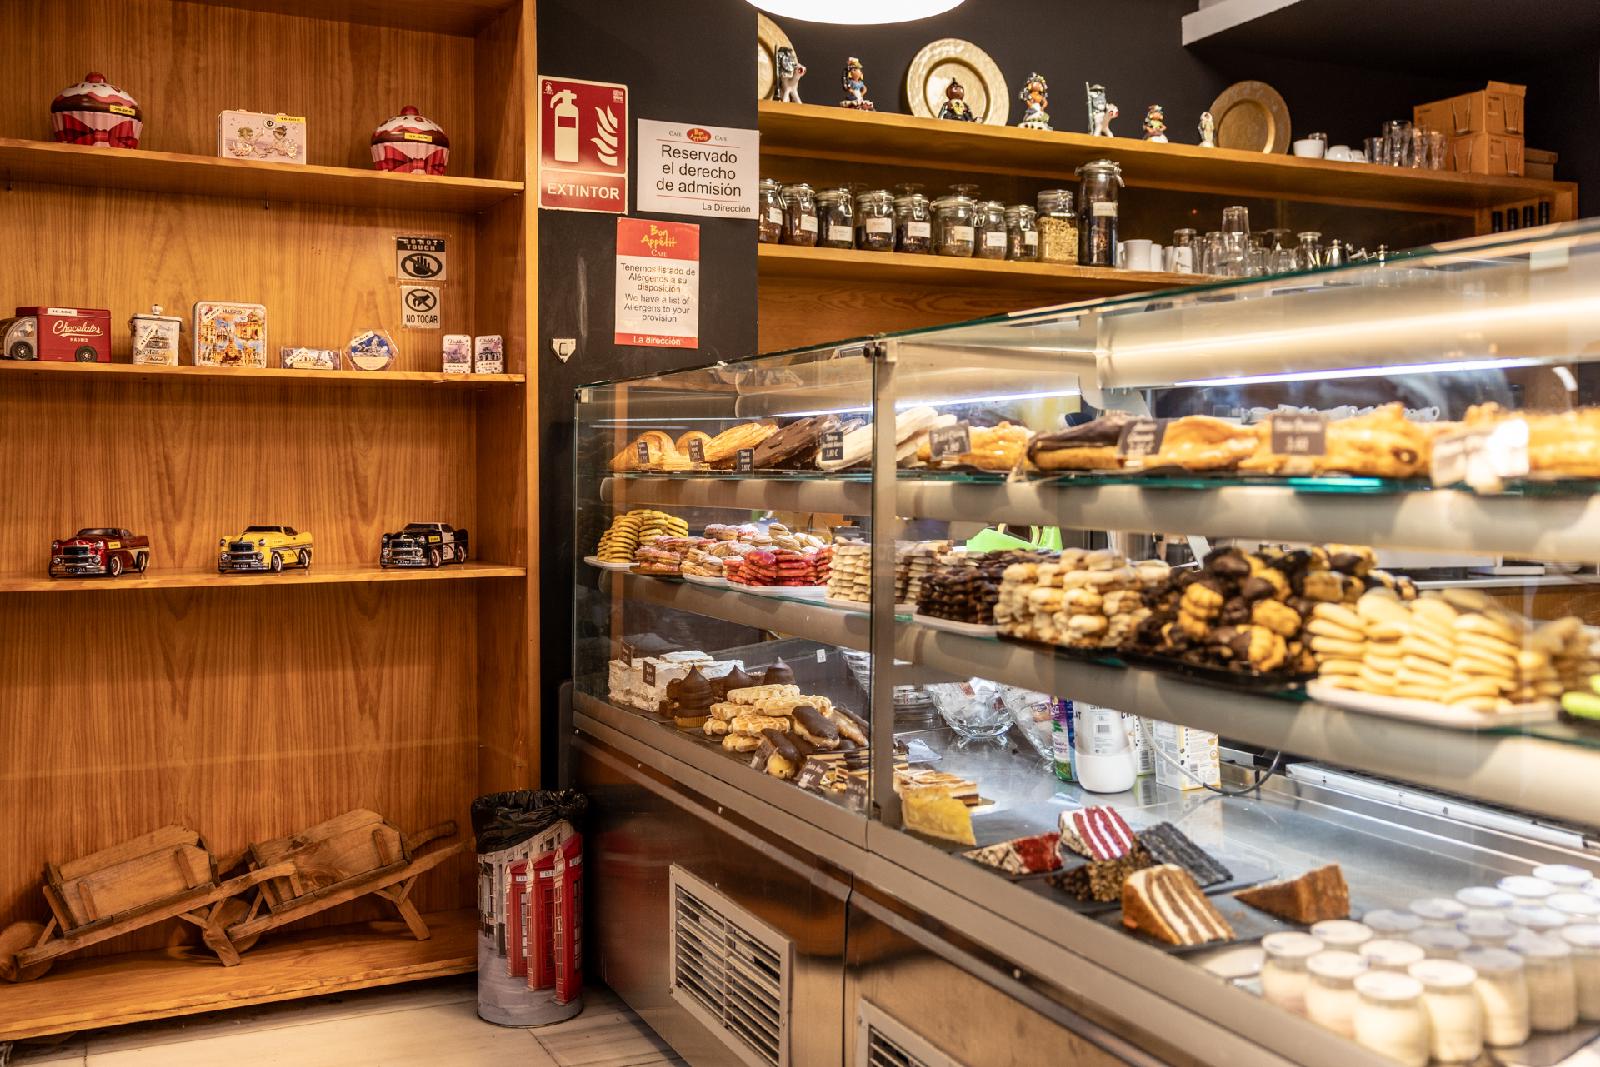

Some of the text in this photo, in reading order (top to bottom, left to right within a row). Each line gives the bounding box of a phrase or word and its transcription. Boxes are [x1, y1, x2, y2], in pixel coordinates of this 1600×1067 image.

[661, 144, 738, 164] Reservado
[662, 162, 736, 180] el derecho
[547, 182, 620, 200] EXTINTOR
[656, 178, 741, 197] de admisión
[702, 202, 750, 213] La Dirección
[650, 224, 668, 239] Bon
[620, 262, 656, 272] Tenemos
[686, 268, 696, 276] de
[624, 294, 638, 302] We
[640, 294, 660, 303] have
[672, 306, 690, 314] your
[406, 314, 438, 324] NO TOCAR
[52, 320, 100, 334] Chocolates
[633, 336, 644, 344] La
